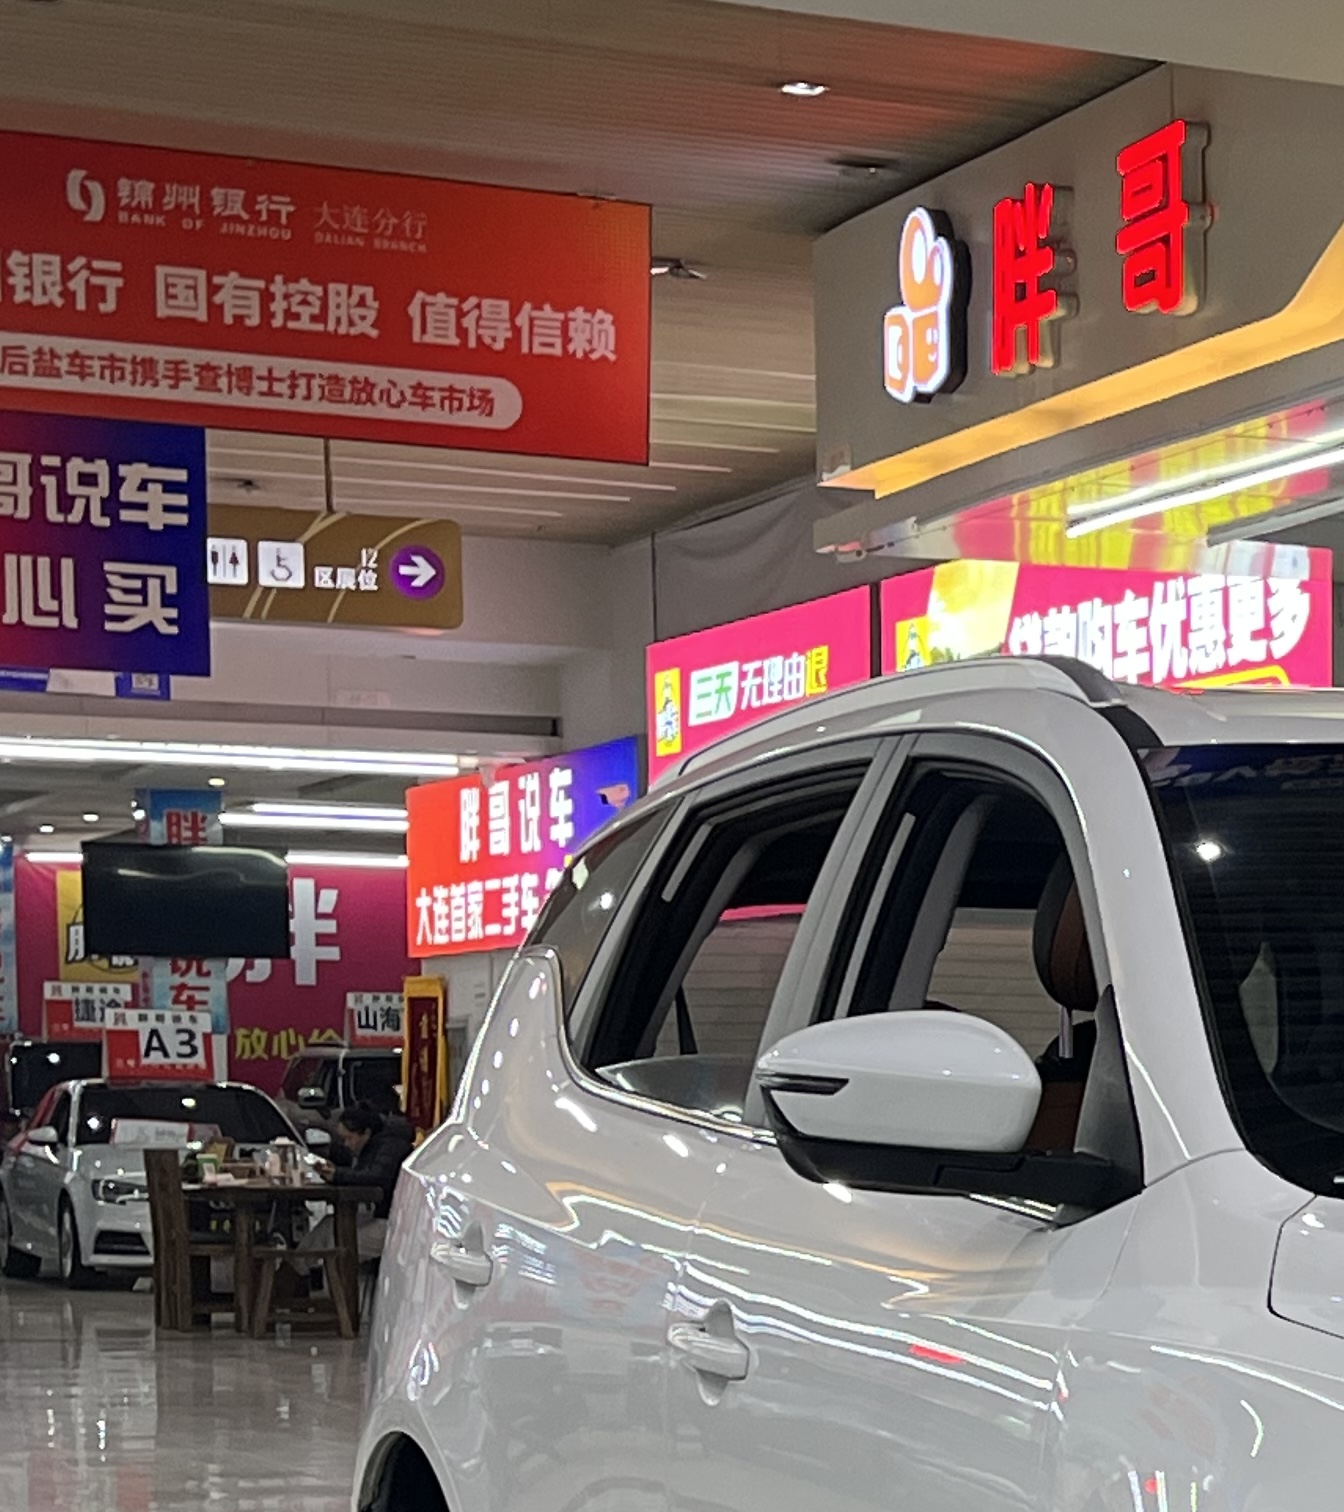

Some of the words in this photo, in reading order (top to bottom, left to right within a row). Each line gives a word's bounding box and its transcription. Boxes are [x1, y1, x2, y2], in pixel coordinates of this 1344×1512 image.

[117, 177, 295, 226] 锦州银行
[314, 201, 428, 242] 大连分行
[117, 210, 167, 228] BANK
[219, 222, 293, 241] JINZHOU
[990, 118, 1190, 375] 胖哥
[6, 250, 125, 314] 银行
[155, 264, 381, 340] 国有控股
[407, 289, 619, 362] 值得信赖
[459, 766, 574, 864] 胖哥说车
[143, 1028, 199, 1059] A3
